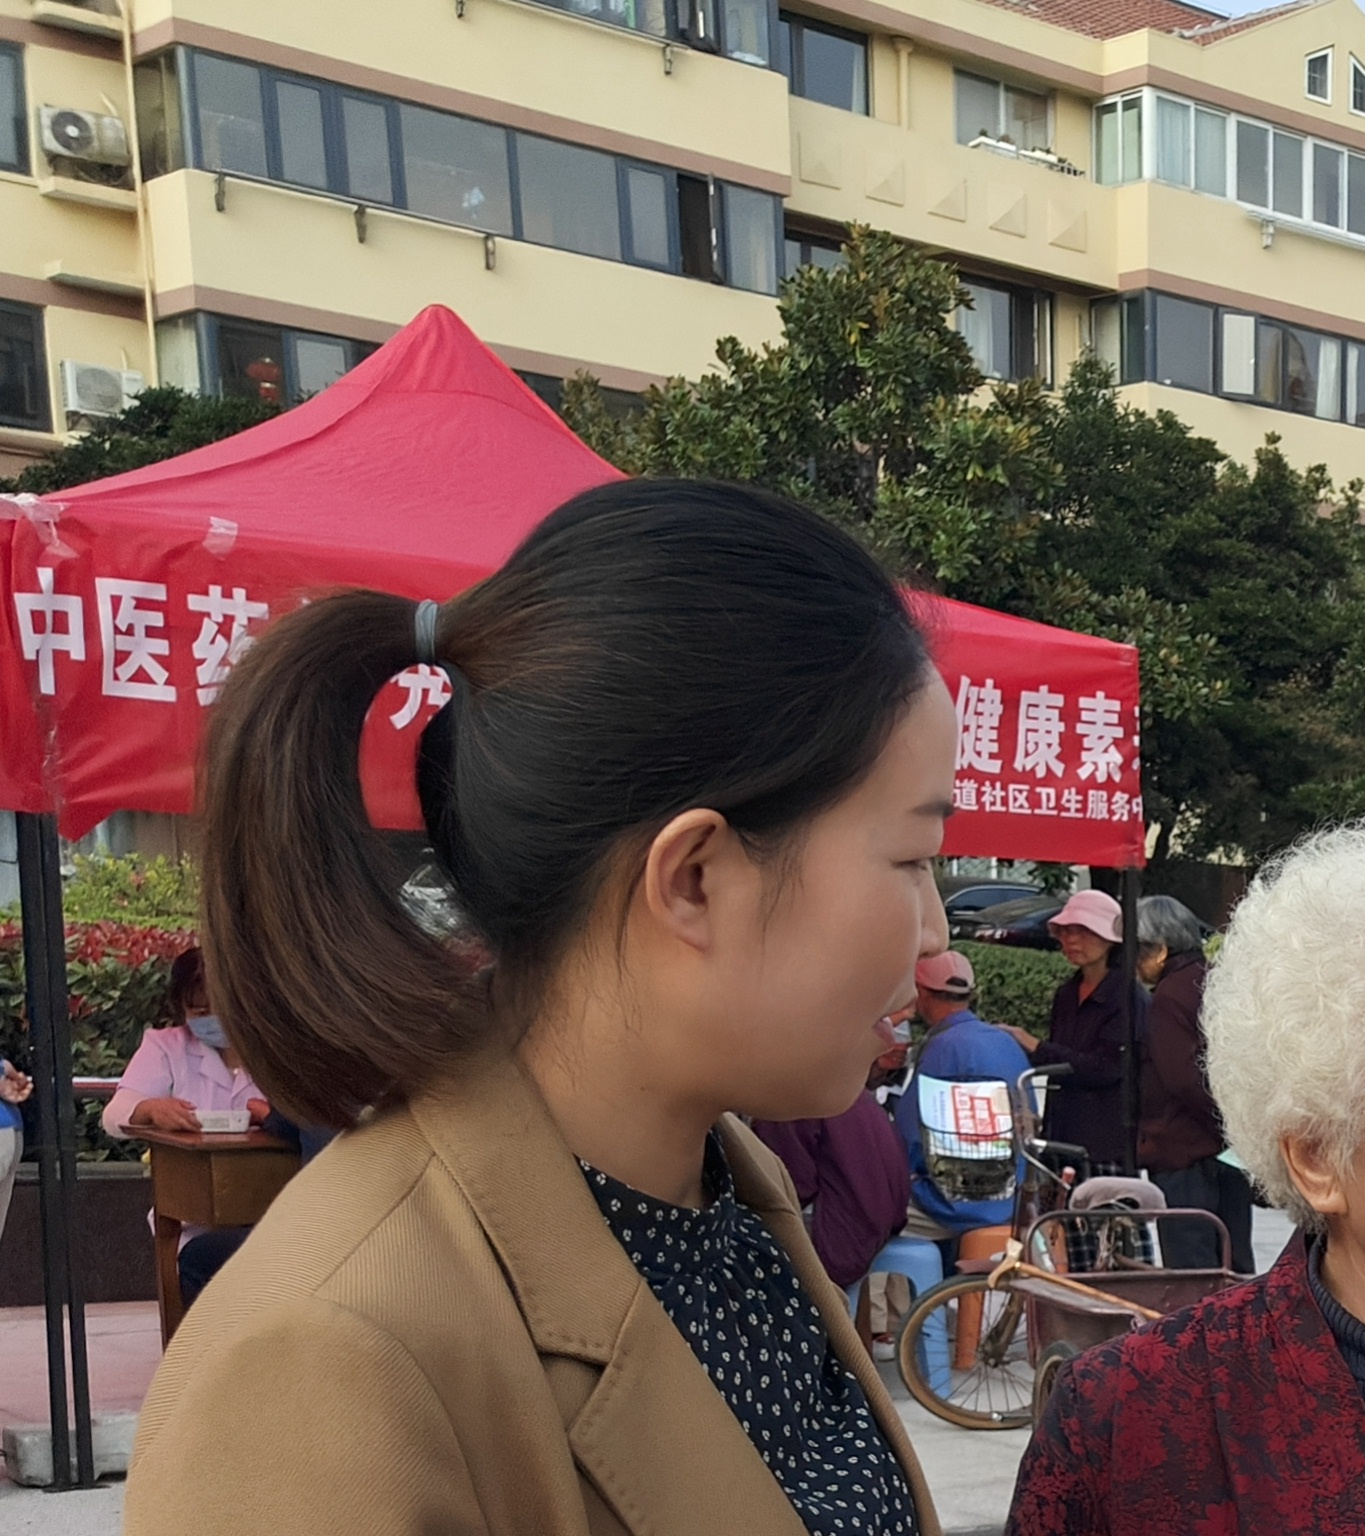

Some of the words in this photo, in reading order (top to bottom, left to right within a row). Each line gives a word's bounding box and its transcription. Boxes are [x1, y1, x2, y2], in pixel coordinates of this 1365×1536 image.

[12, 567, 269, 706] 中医药
[955, 674, 1141, 784] 健康素
